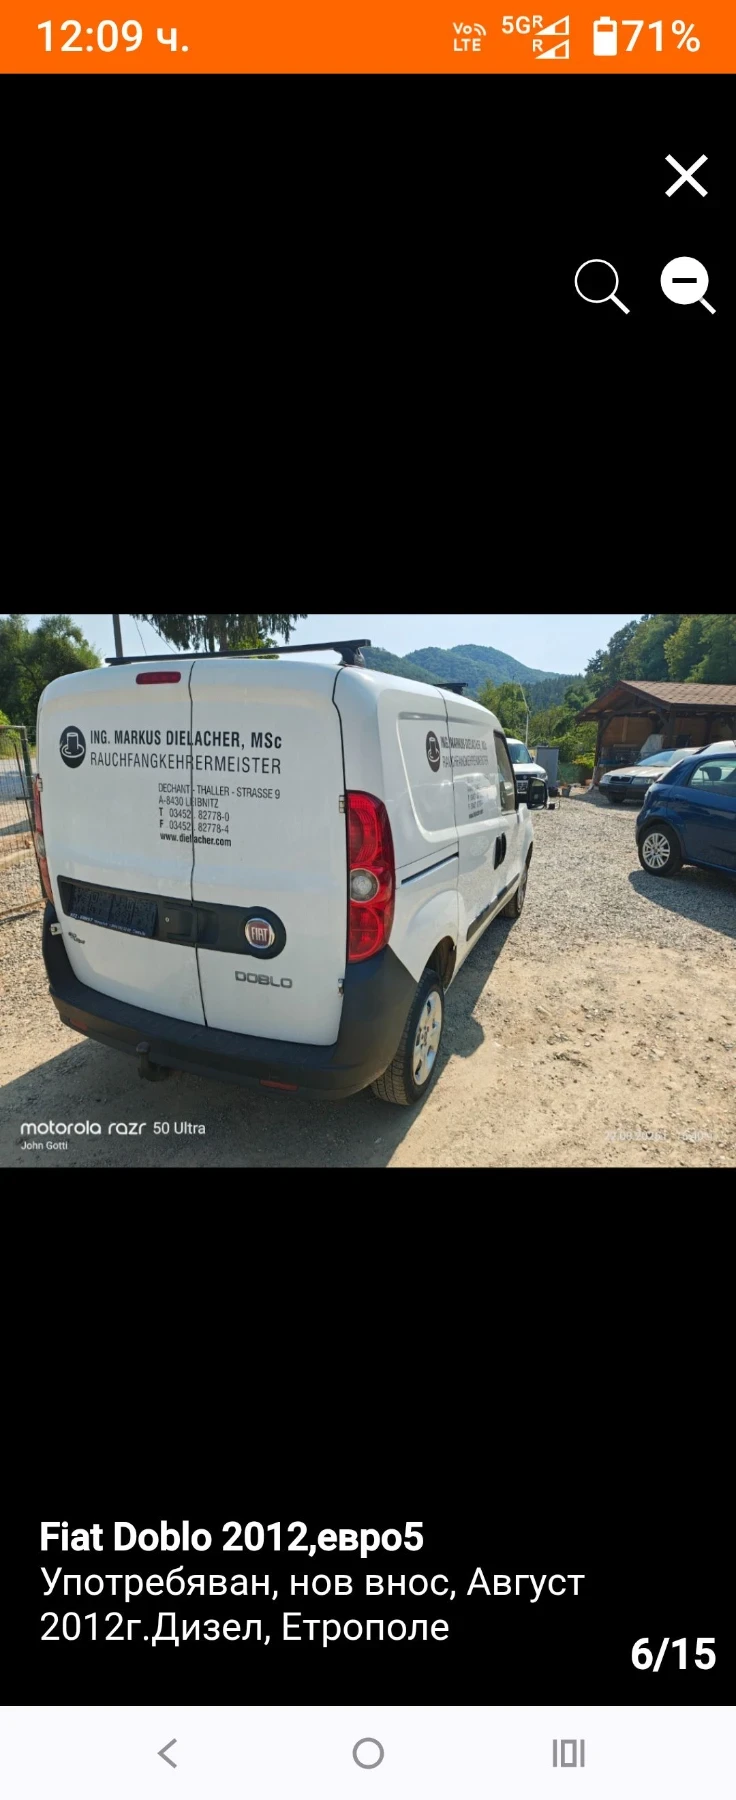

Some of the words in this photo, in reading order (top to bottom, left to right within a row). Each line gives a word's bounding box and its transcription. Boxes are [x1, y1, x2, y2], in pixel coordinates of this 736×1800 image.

[37, 20, 142, 52] 12:09
[156, 28, 189, 52] ч.
[453, 38, 482, 52] LTE
[621, 19, 701, 53] 71%
[90, 730, 110, 745] ING.
[114, 730, 162, 746] MARKUS
[166, 730, 246, 750] DIELACHER,
[251, 732, 282, 749] MSc
[90, 752, 282, 775] RAUCHFANGKEHRERMEISTER
[158, 783, 190, 795] DECHANT
[197, 785, 230, 797] THALLER
[236, 787, 273, 799] STRASSE
[274, 789, 281, 800] 9
[158, 795, 184, 807] A-8430
[158, 807, 164, 817] T
[198, 810, 230, 822] 82778-0
[159, 819, 164, 829] F
[198, 822, 230, 834] 82778-4
[251, 926, 269, 942] FIAT
[234, 970, 294, 989] DOBLO
[40, 1520, 104, 1552] Fiat
[114, 1519, 213, 1552] Doblo
[222, 1520, 424, 1559] 2012,евро5
[40, 1565, 278, 1603] Употребяван,
[290, 1574, 353, 1596] нов
[365, 1573, 456, 1601] внос,
[466, 1566, 586, 1604] Август
[40, 1611, 271, 1647] 2012г.Дизел,
[283, 1611, 449, 1648] Етрополе
[631, 1637, 717, 1673] 6/15
